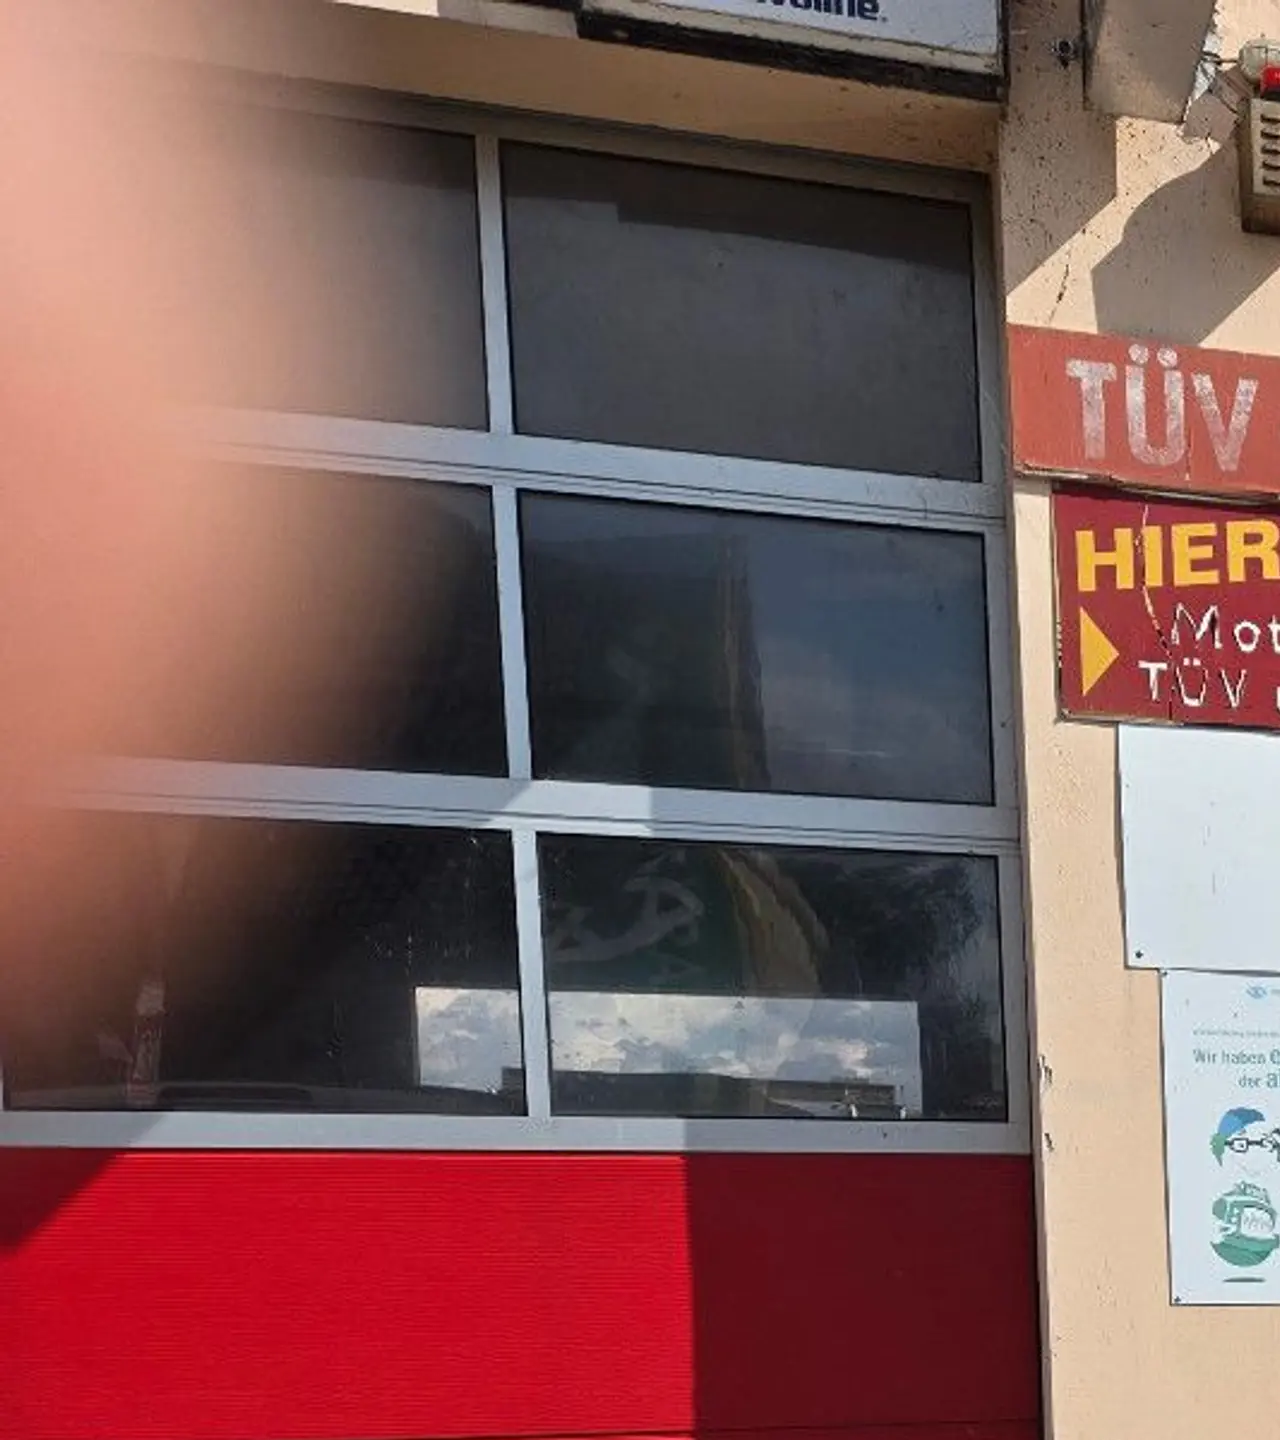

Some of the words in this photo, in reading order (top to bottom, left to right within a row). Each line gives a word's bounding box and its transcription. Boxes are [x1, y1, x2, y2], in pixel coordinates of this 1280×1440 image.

[1066, 343, 1259, 472] TÜV
[1138, 657, 1248, 709] TÜV
[1193, 1048, 1217, 1065] Wir
[1222, 1048, 1266, 1065] haben
